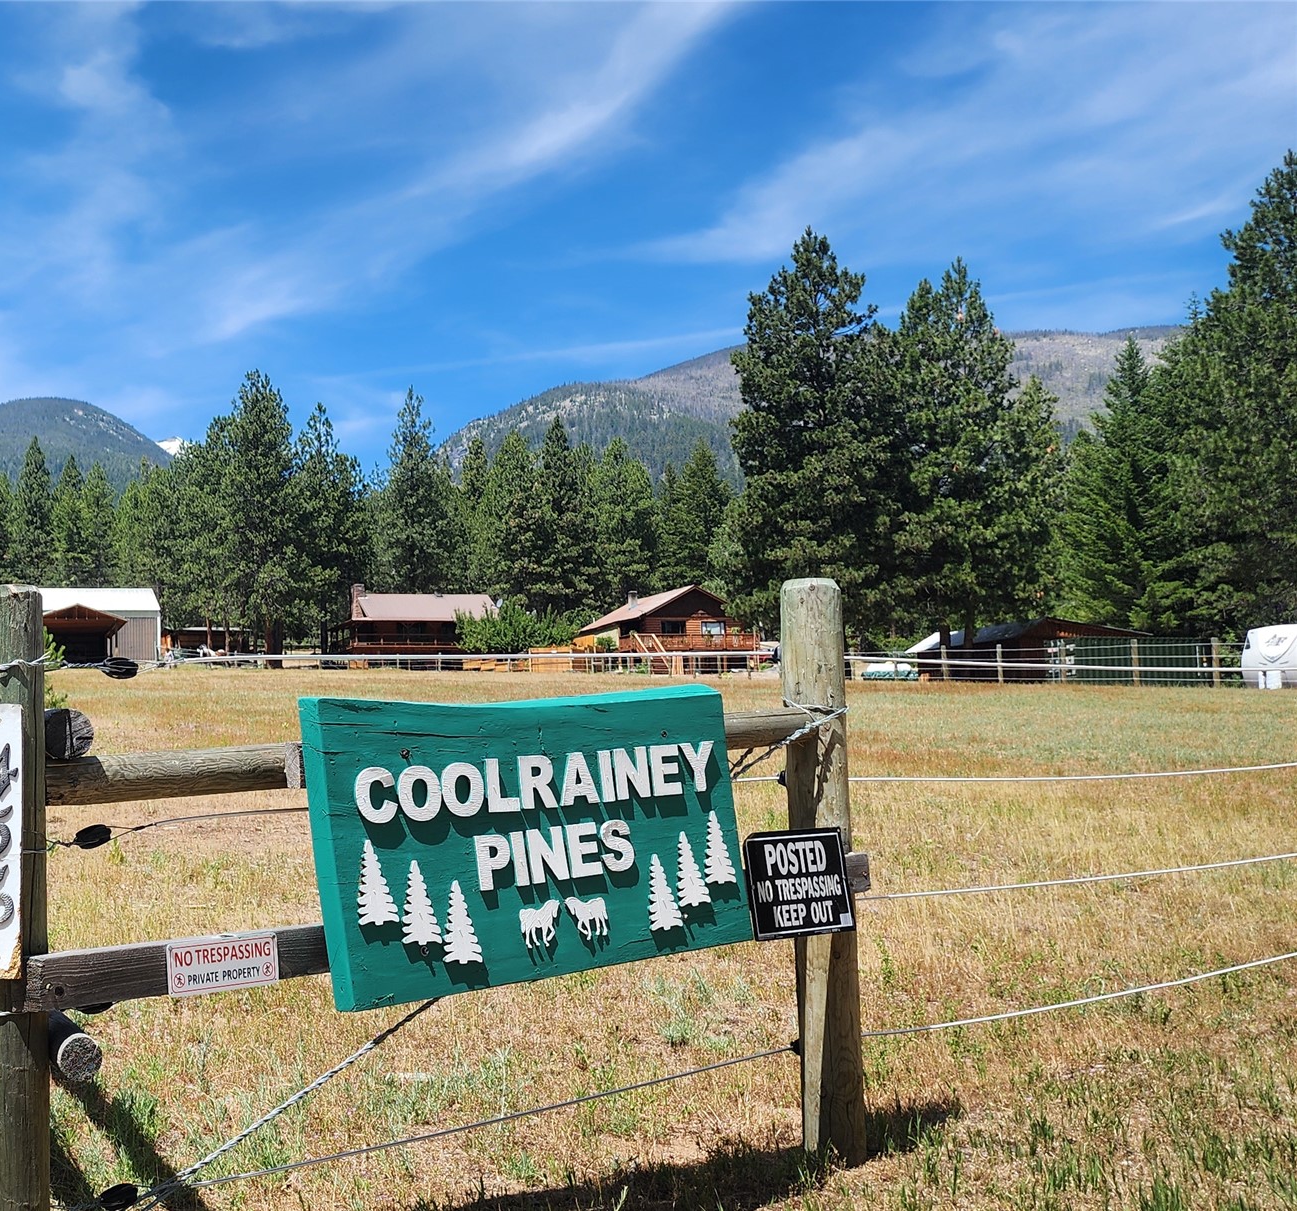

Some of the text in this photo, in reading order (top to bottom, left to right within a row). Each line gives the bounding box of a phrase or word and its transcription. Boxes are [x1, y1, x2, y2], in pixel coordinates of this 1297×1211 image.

[354, 740, 714, 824] COOLRAINEY
[473, 819, 635, 891] PINES
[764, 840, 826, 876] POSTED
[757, 874, 842, 903] NO TRESPASSING
[773, 900, 833, 927] KEEP OUT
[174, 941, 271, 967] NO TRESPASSING
[188, 966, 260, 985] PRIVATE PROPERTY
